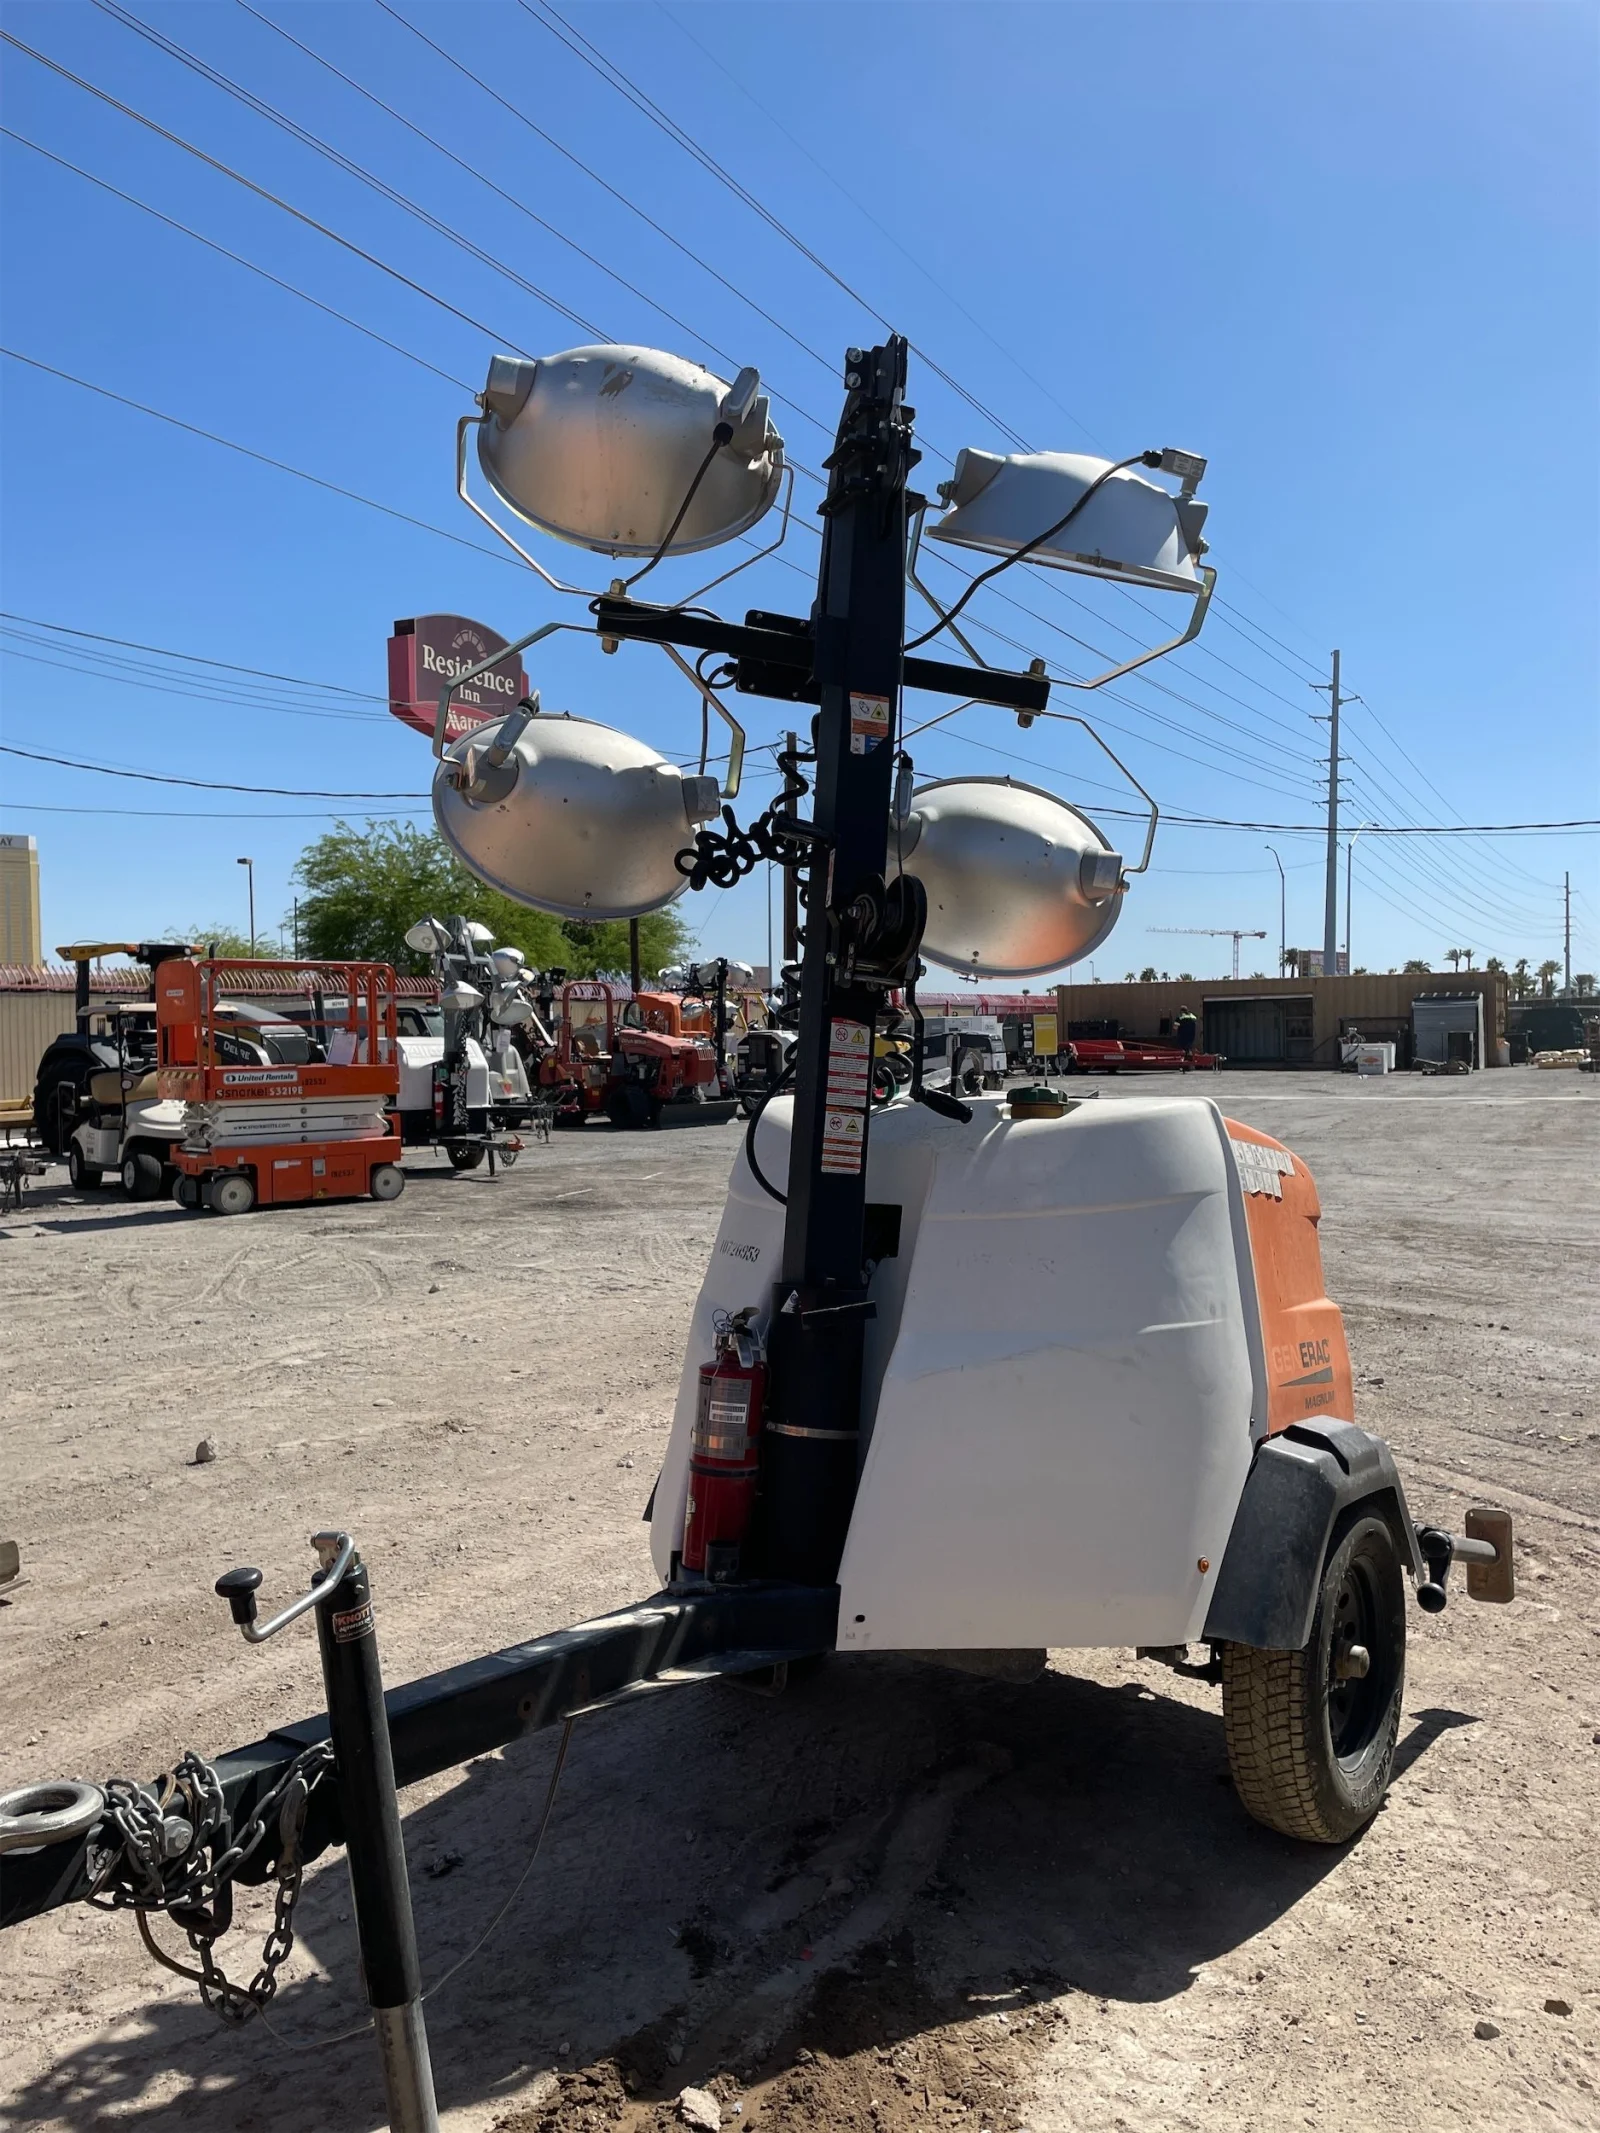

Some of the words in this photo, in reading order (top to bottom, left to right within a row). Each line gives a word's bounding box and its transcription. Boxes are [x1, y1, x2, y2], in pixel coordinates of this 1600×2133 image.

[423, 645, 515, 695] Residence
[460, 685, 481, 703] Inn
[238, 1074, 265, 1082] United
[265, 1073, 294, 1081] Rentals
[224, 1087, 267, 1098] snorkel
[269, 1086, 304, 1096] S3219E
[1272, 1338, 1331, 1373] GENERAC
[1304, 1390, 1335, 1410] MAGNUM
[336, 1607, 370, 1626] KNOTT
